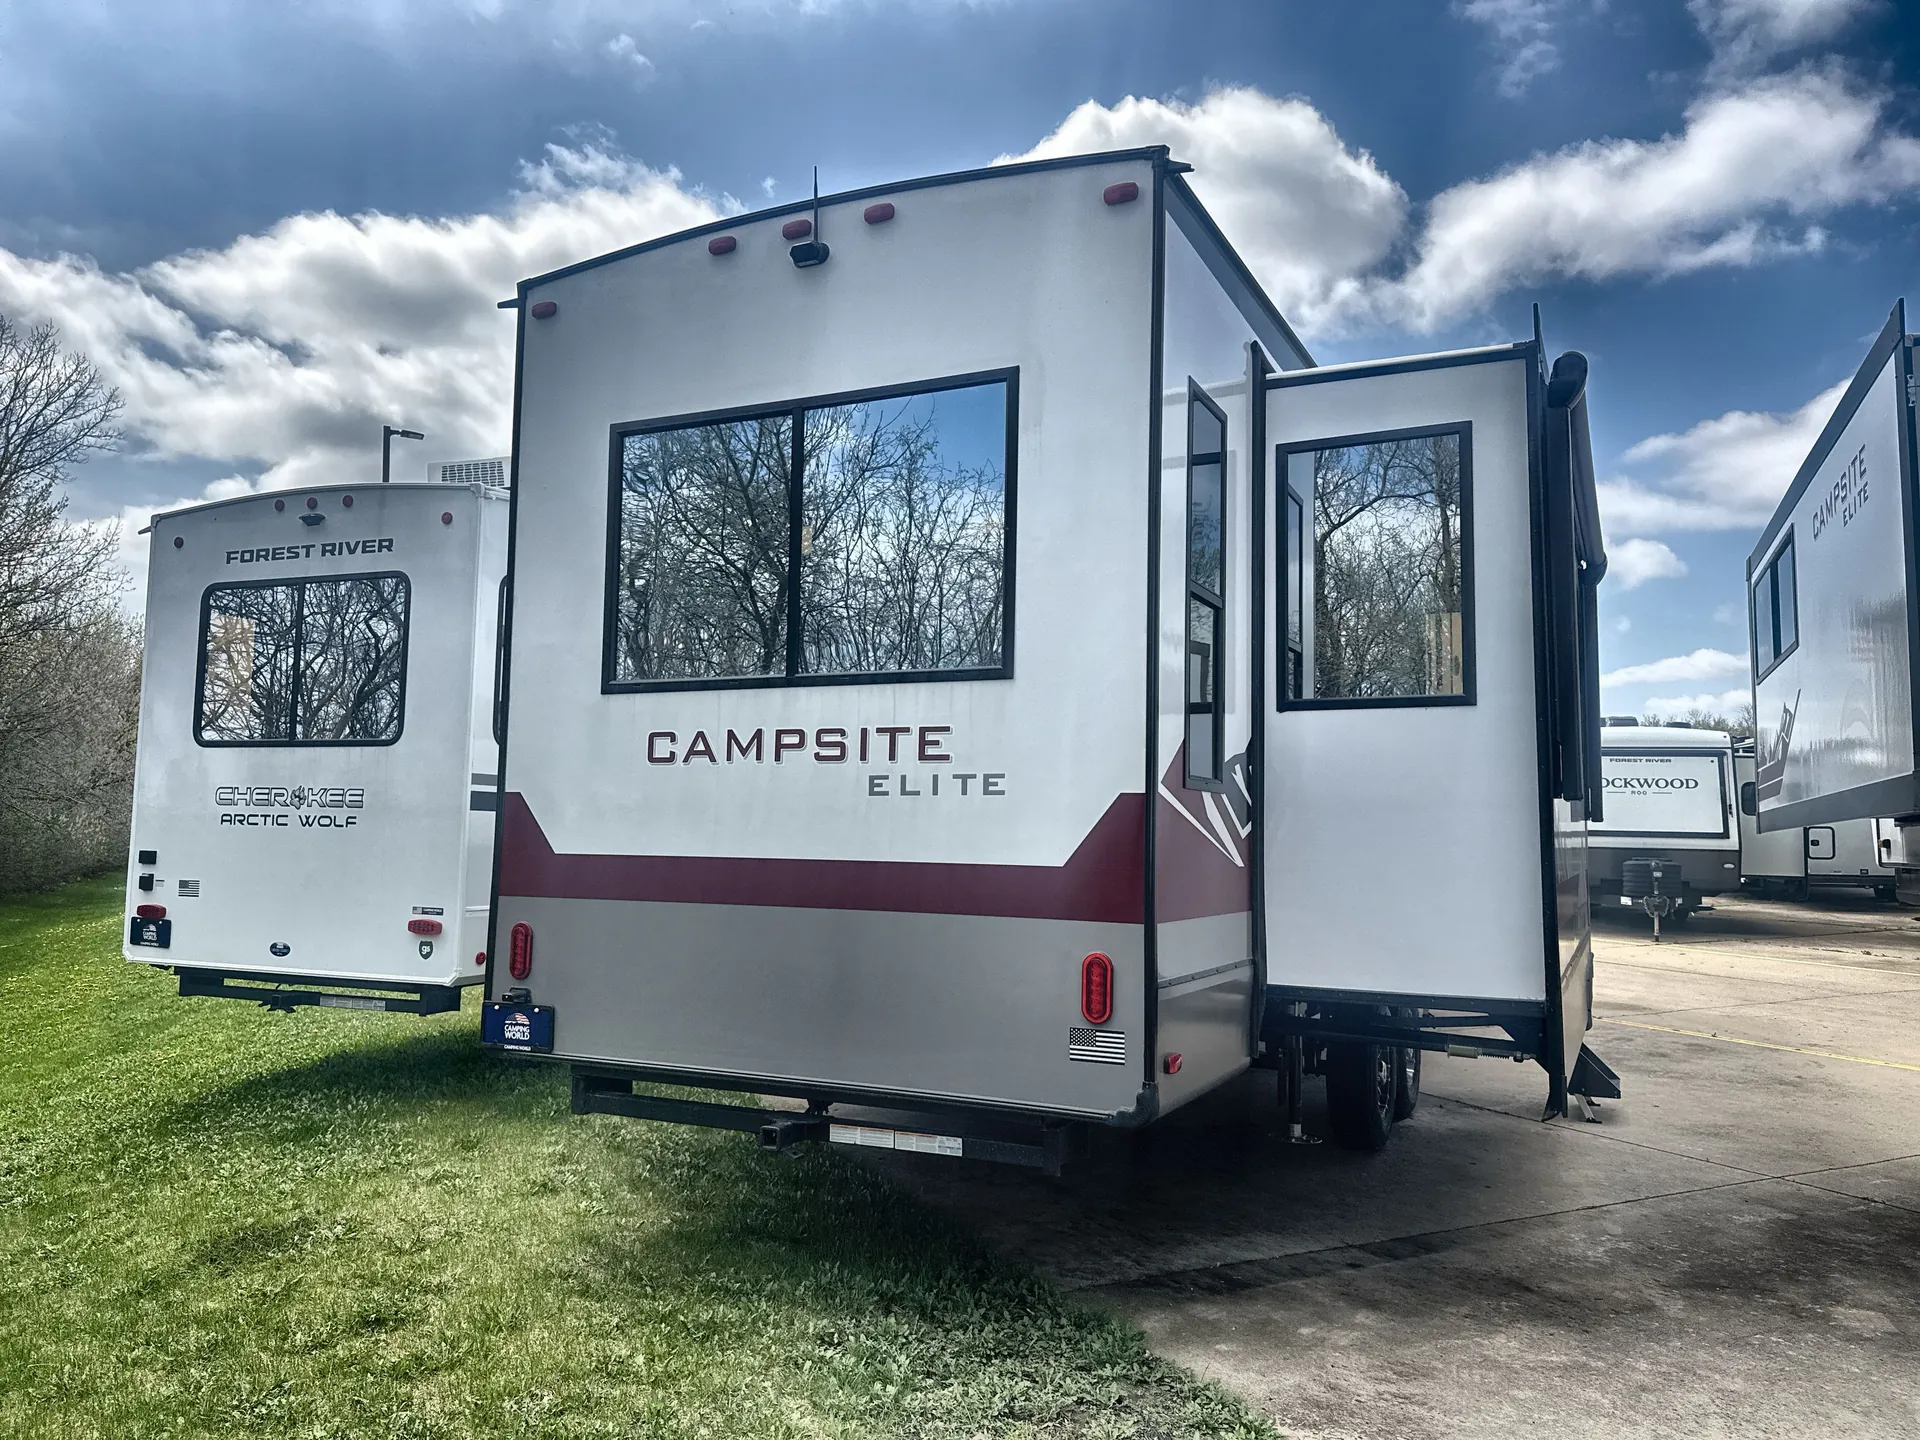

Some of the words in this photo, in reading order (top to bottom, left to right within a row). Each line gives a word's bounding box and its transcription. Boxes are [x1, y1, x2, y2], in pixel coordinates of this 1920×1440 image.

[1812, 443, 1867, 541] CAMPSITE
[1842, 480, 1869, 528] ELITE
[225, 544, 316, 565] FOREST
[320, 537, 394, 558] RIVER
[646, 725, 954, 766] CAMPSITE
[868, 773, 1006, 797] ELITE
[1601, 777, 1699, 789] OCKWOOD
[220, 813, 289, 827] ARCTIC
[298, 814, 358, 828] WOLF
[504, 1024, 530, 1033] CAMPING
[504, 1031, 530, 1040] WORLD
